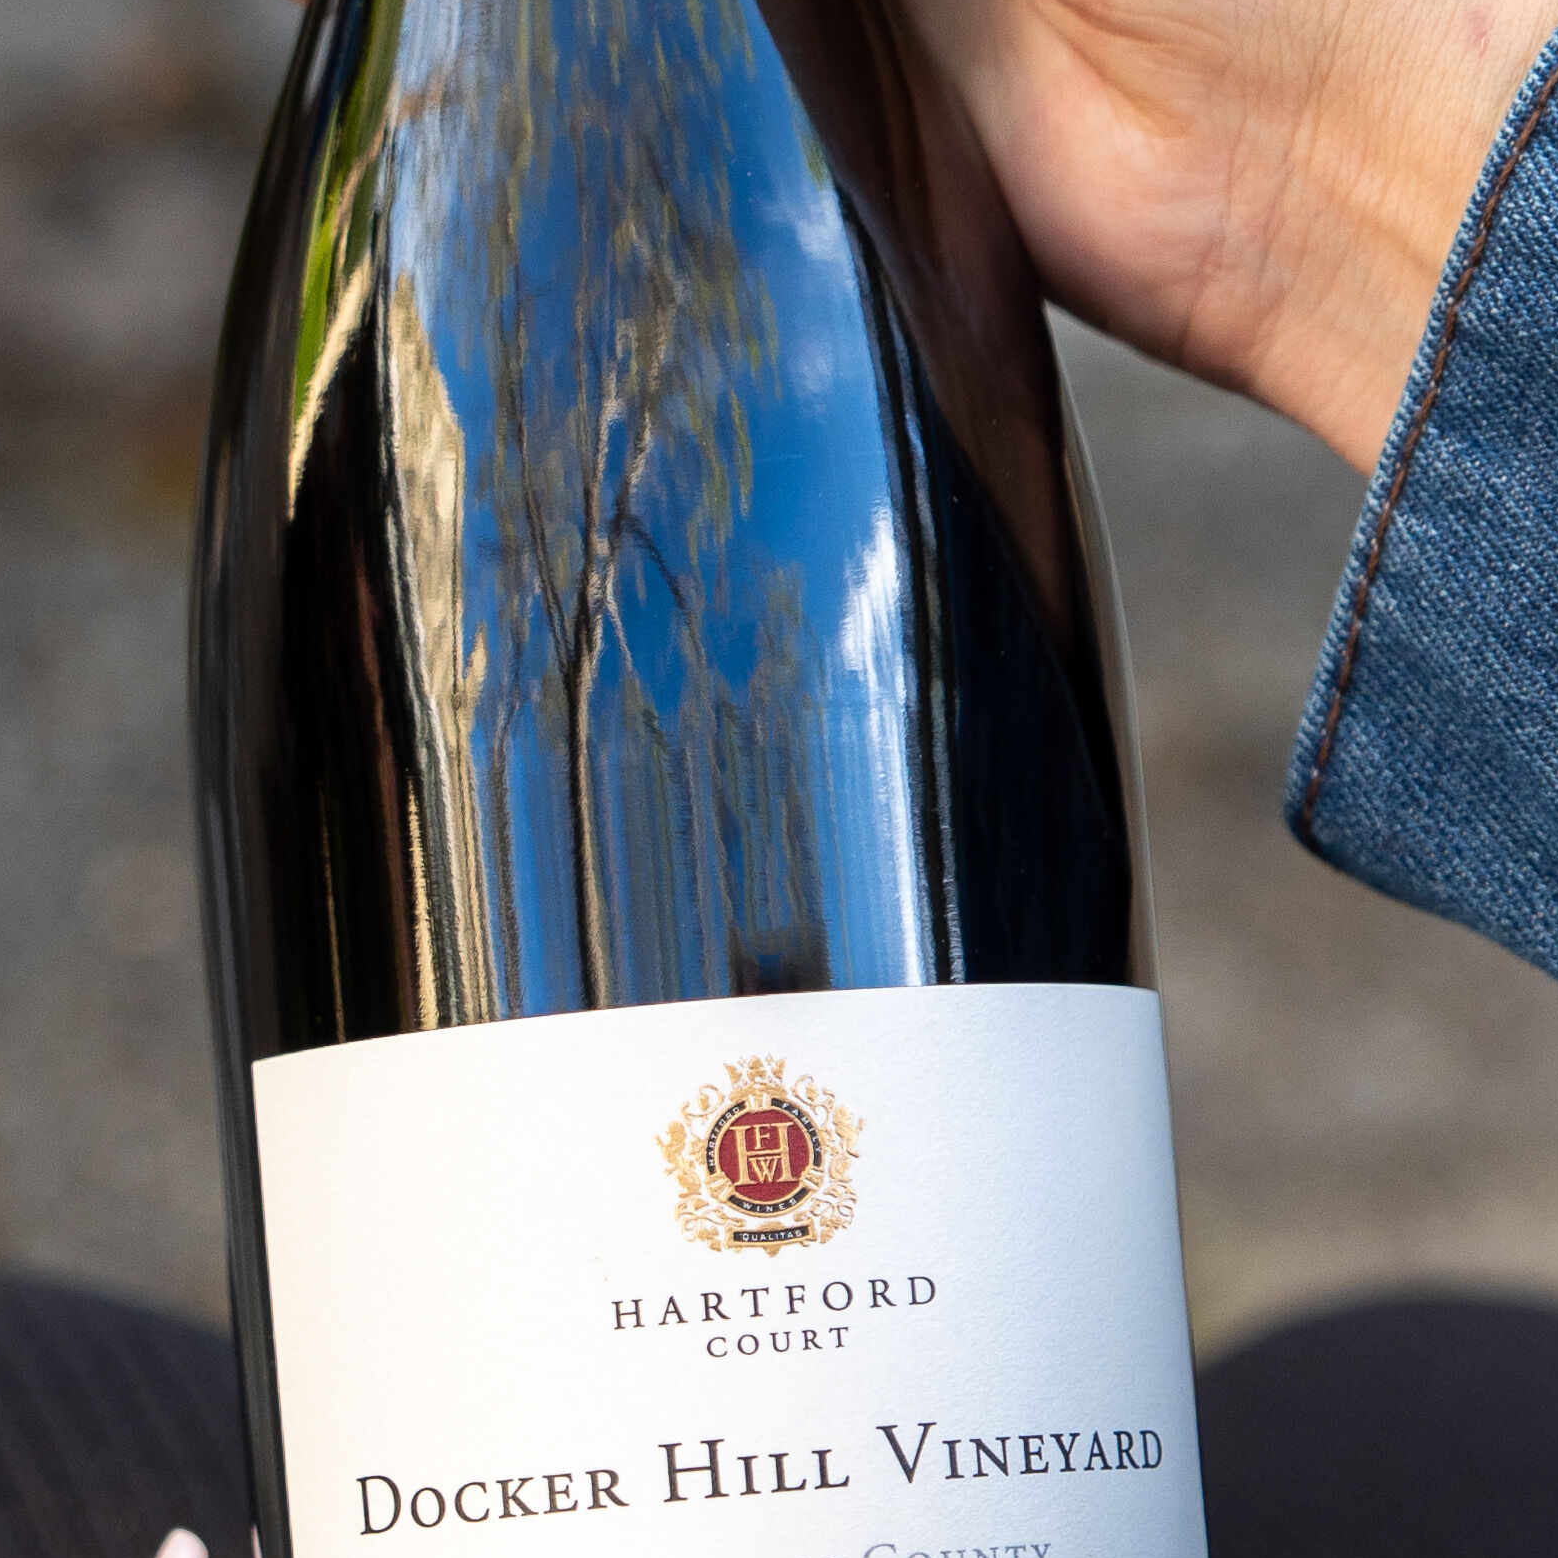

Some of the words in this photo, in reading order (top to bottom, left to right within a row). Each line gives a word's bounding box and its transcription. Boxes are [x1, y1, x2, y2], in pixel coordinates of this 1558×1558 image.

[708, 1105, 741, 1167] HARTFORD
[782, 1102, 822, 1153] FAMILY
[742, 1198, 797, 1213] WINES
[612, 1276, 935, 1330] HARTFORD
[706, 1327, 848, 1358] COURT
[659, 1439, 849, 1502] HILL
